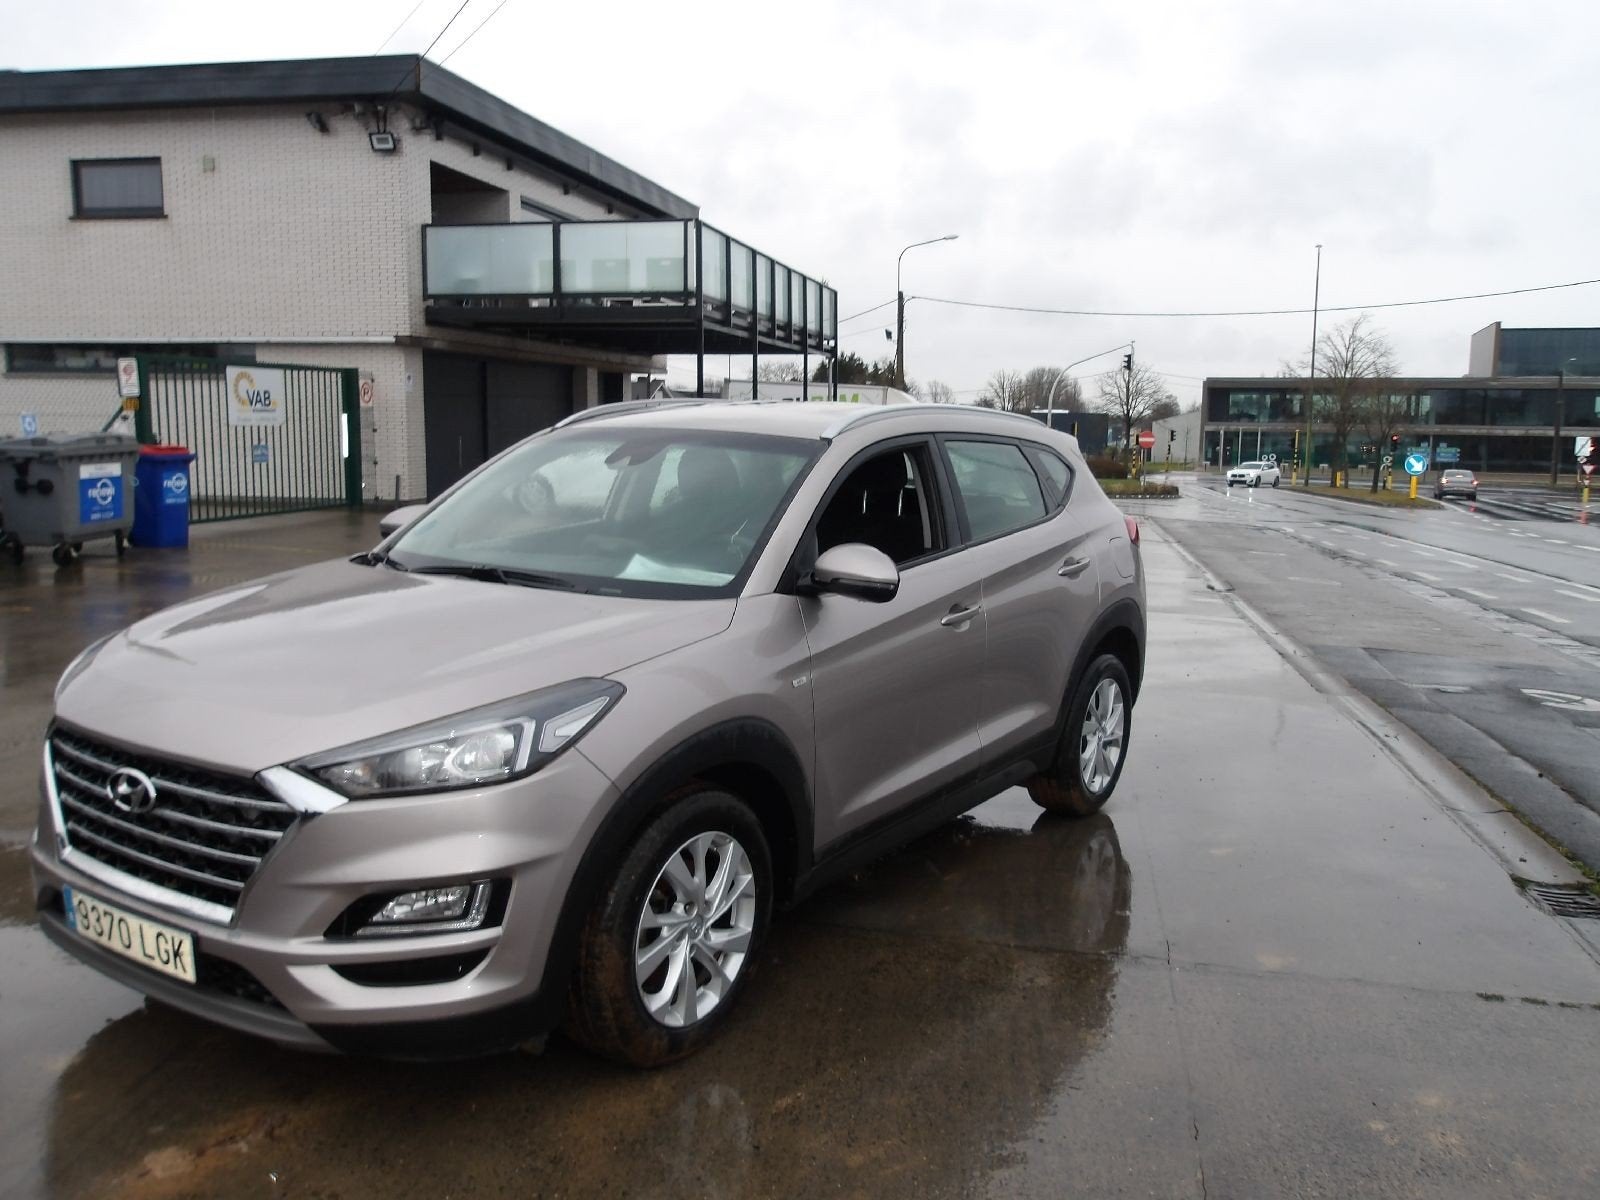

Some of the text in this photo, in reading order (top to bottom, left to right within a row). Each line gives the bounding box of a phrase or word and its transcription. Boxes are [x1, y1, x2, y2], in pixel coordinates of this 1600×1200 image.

[246, 389, 271, 407] VAB
[77, 900, 187, 973] 9370 LGK
